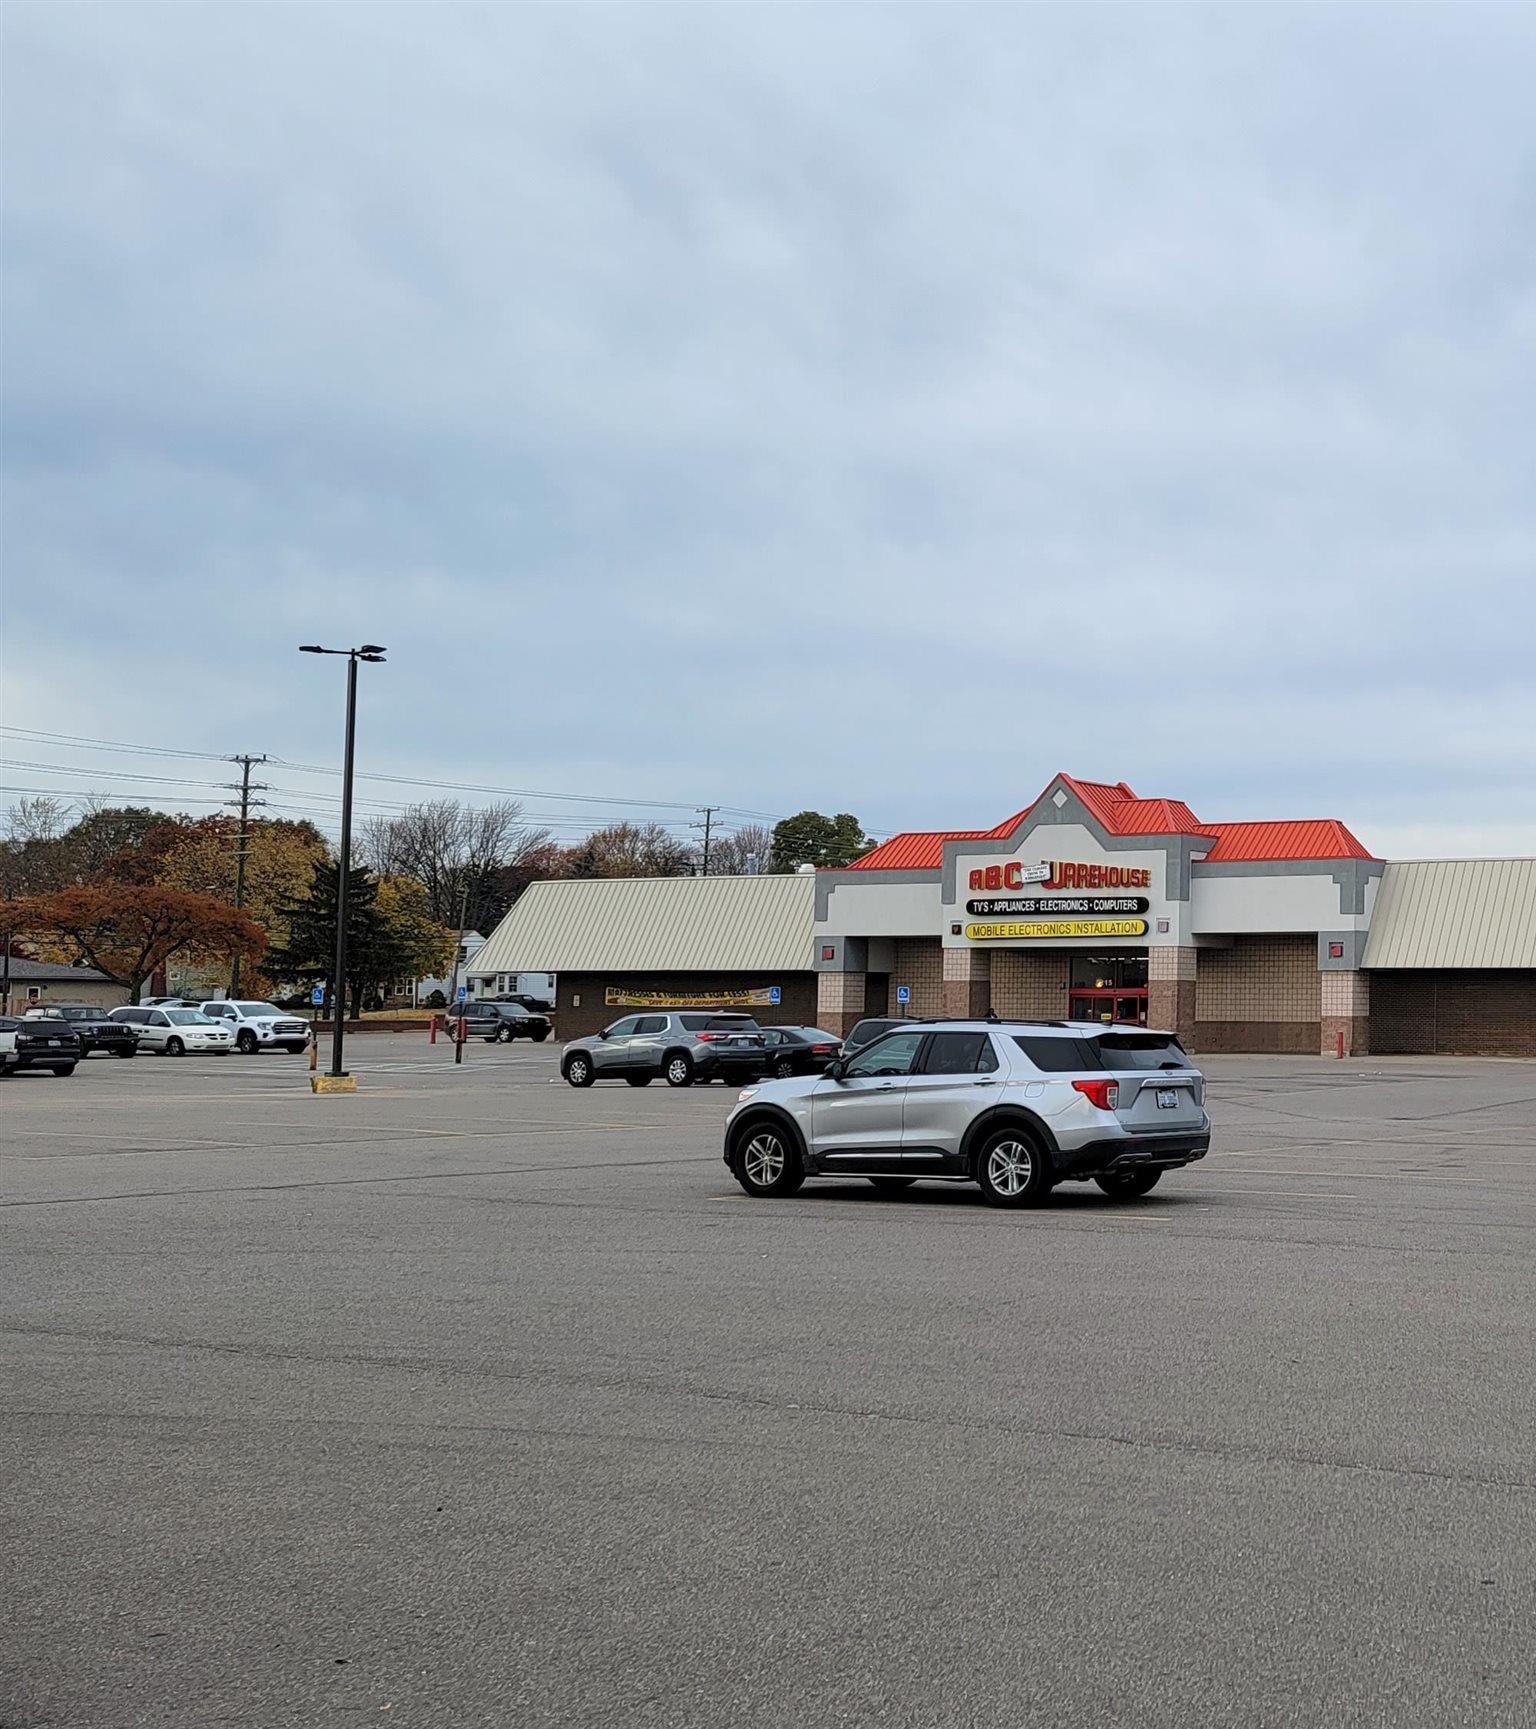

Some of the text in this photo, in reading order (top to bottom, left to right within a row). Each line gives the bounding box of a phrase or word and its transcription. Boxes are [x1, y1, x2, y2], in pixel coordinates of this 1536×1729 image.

[968, 861, 1023, 890] ABC
[1041, 860, 1152, 890] WAREHOUSE
[973, 899, 1138, 913] TV'S APPLIANCES ELECTRONICS COMPUTERS
[972, 921, 1138, 937] MOBILE ELECTRONICS INSTALLATION
